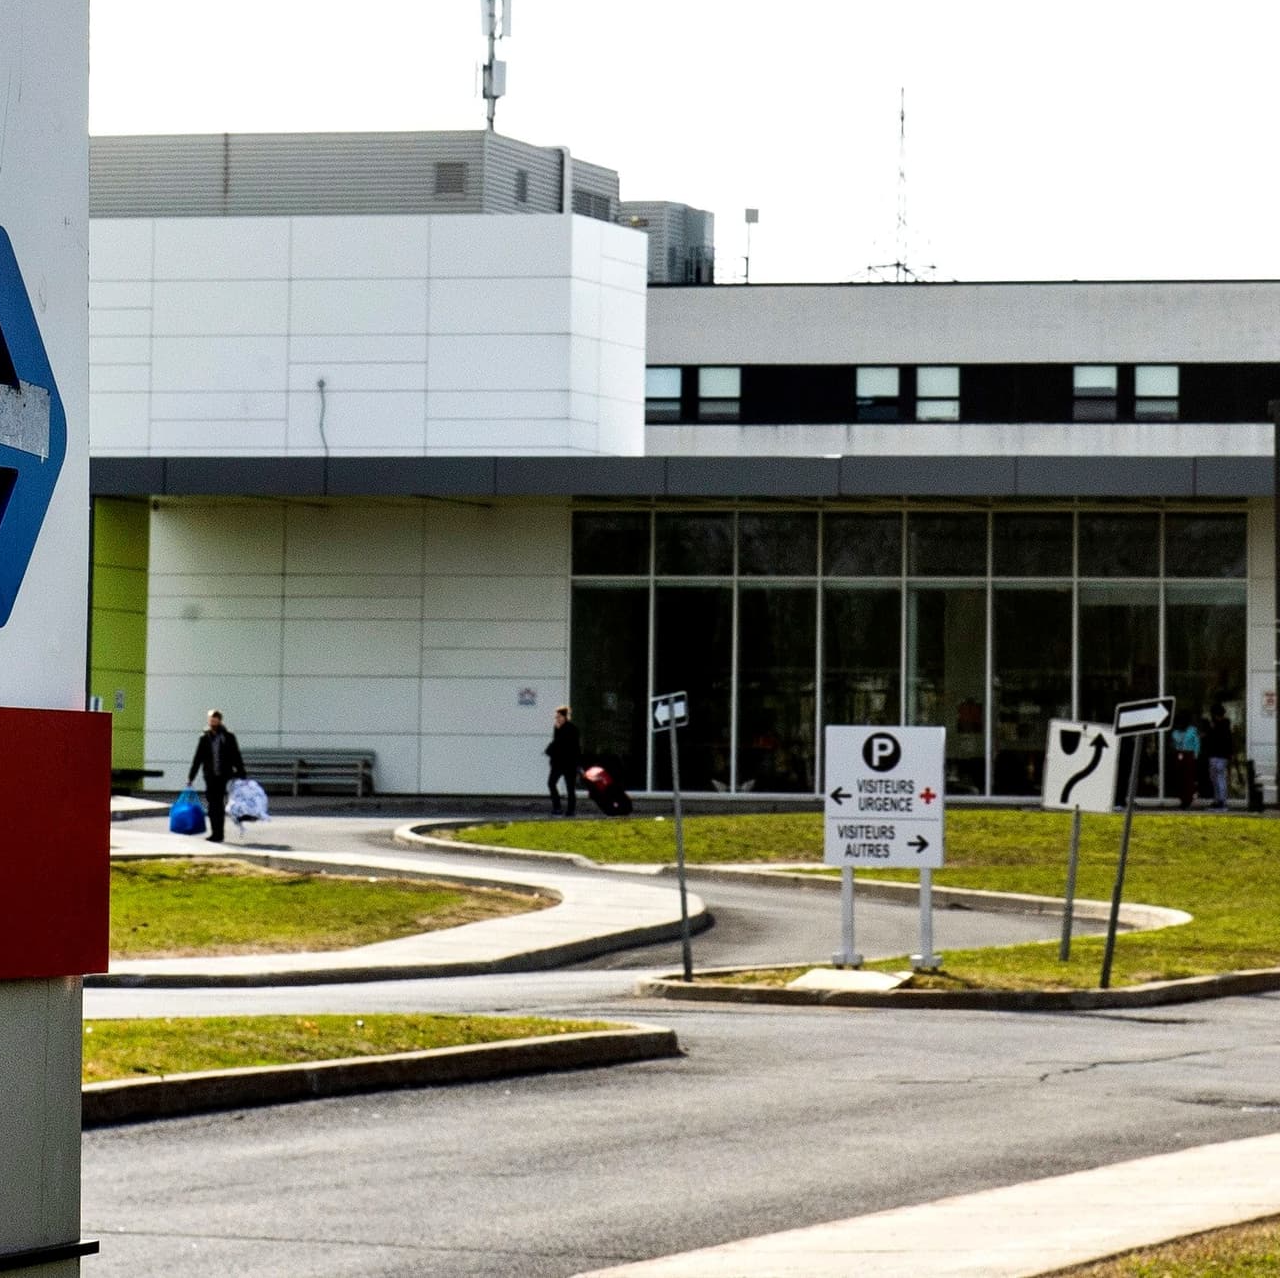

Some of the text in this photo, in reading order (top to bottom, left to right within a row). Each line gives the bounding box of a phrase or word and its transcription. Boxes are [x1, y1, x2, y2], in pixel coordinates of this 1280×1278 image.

[872, 738, 894, 767] P
[857, 779, 914, 794] VISITEURS
[858, 797, 913, 812] URGENCE
[837, 825, 895, 840] VISITEURS
[845, 843, 890, 858] AUTRES
